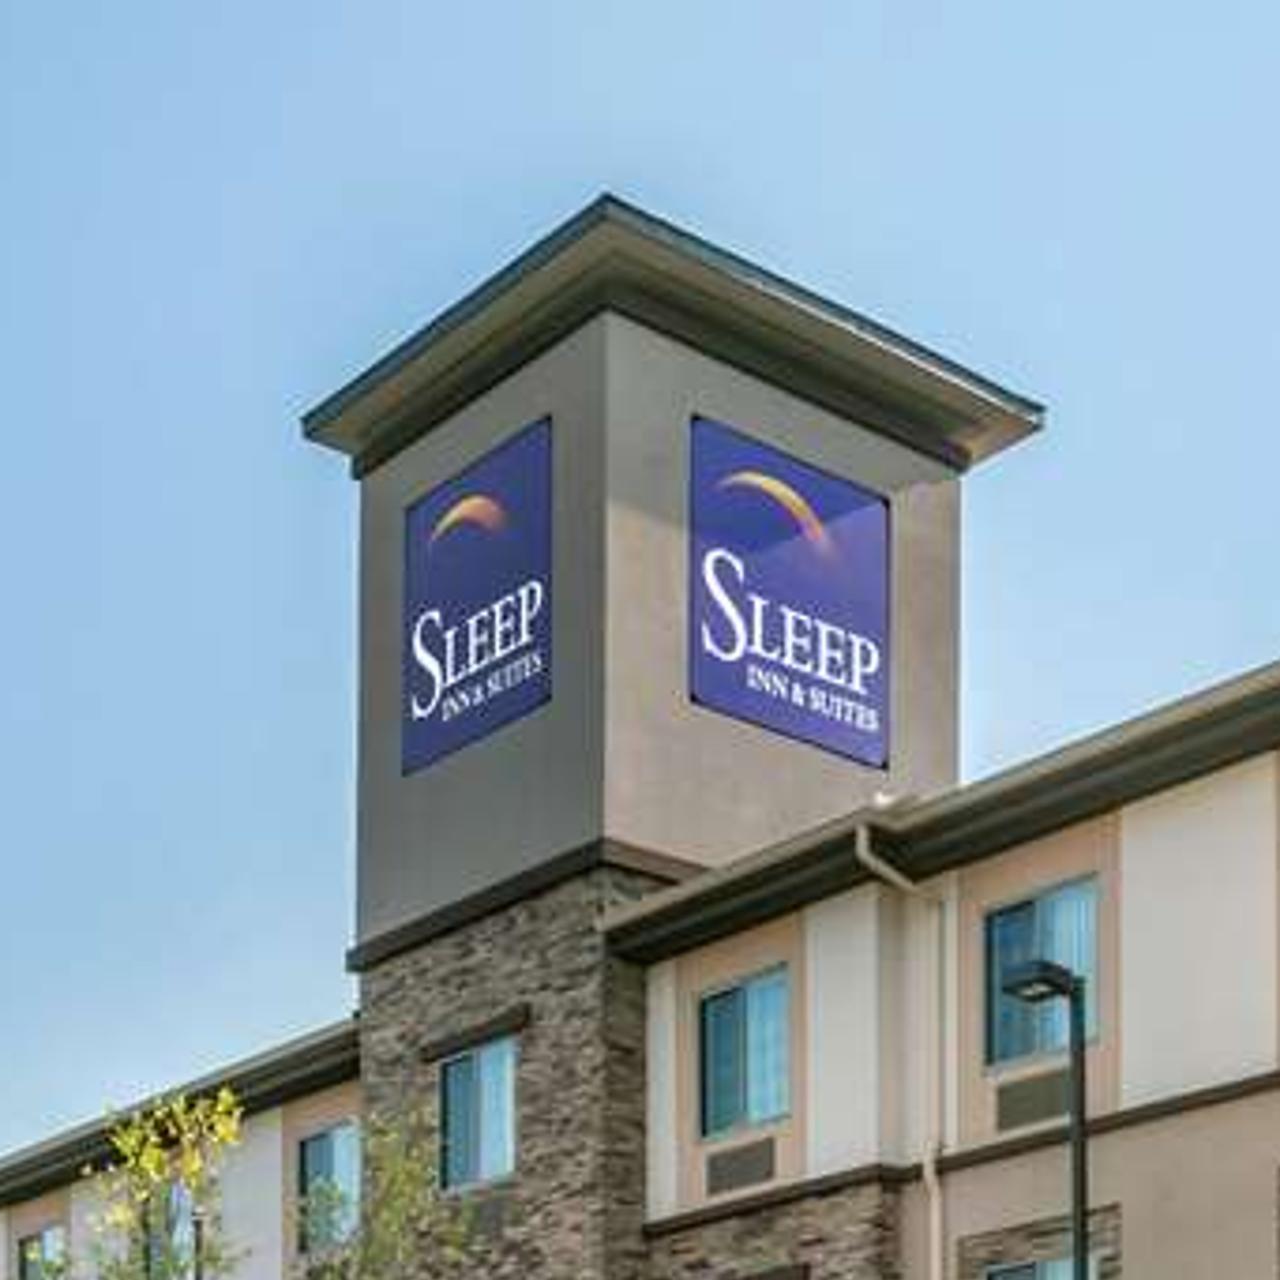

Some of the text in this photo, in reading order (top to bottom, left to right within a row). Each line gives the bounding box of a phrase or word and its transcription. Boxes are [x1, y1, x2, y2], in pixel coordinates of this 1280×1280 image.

[411, 580, 543, 721] SLEEP
[700, 548, 880, 695] SLEEP
[746, 664, 880, 731] INN & SUITES
